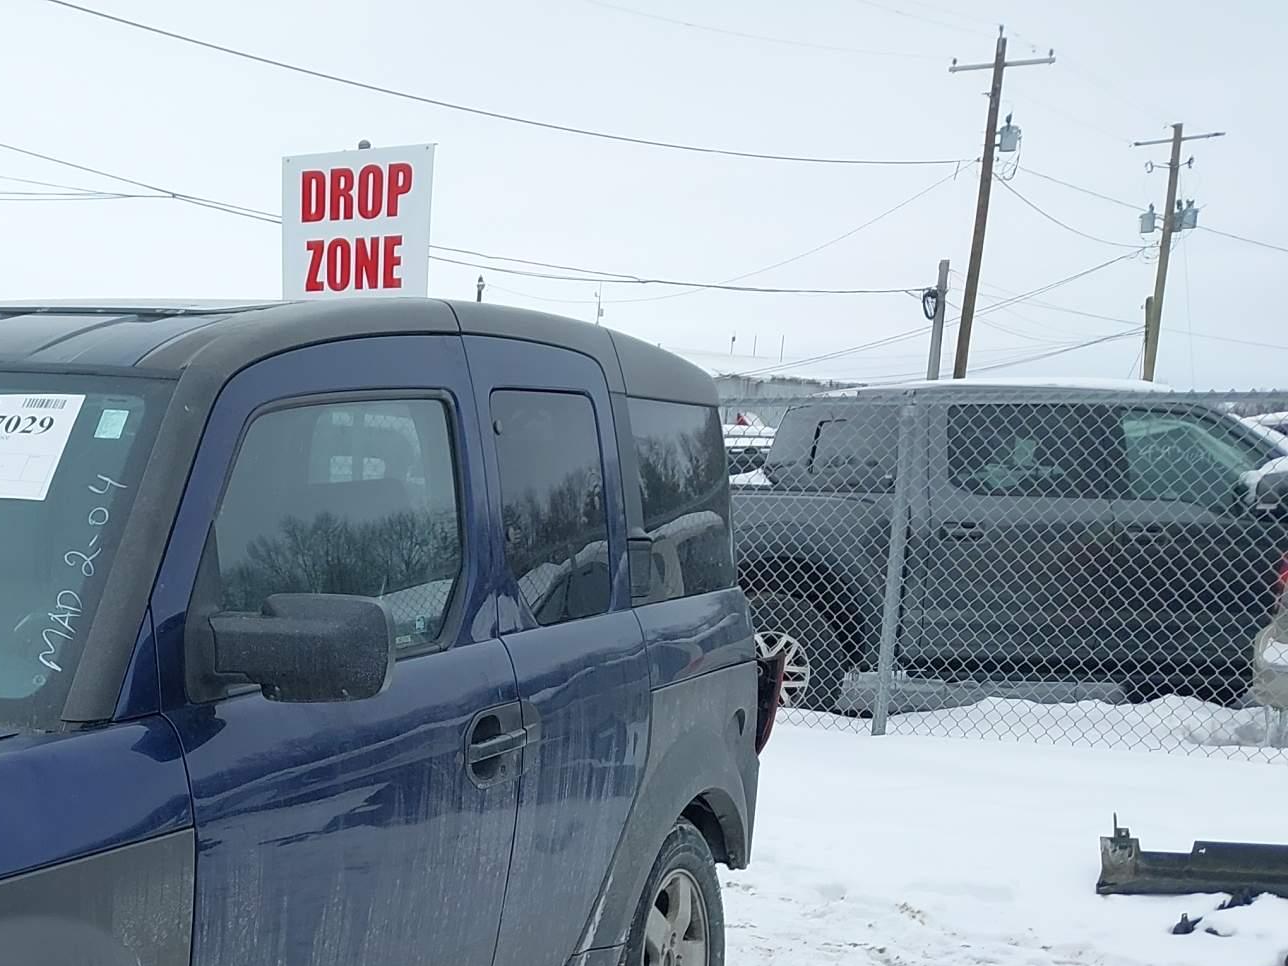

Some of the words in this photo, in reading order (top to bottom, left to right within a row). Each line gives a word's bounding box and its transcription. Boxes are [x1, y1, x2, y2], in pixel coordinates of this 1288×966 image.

[301, 162, 413, 223] DROP
[305, 235, 403, 292] ZONE
[39, 590, 82, 671] MAD
